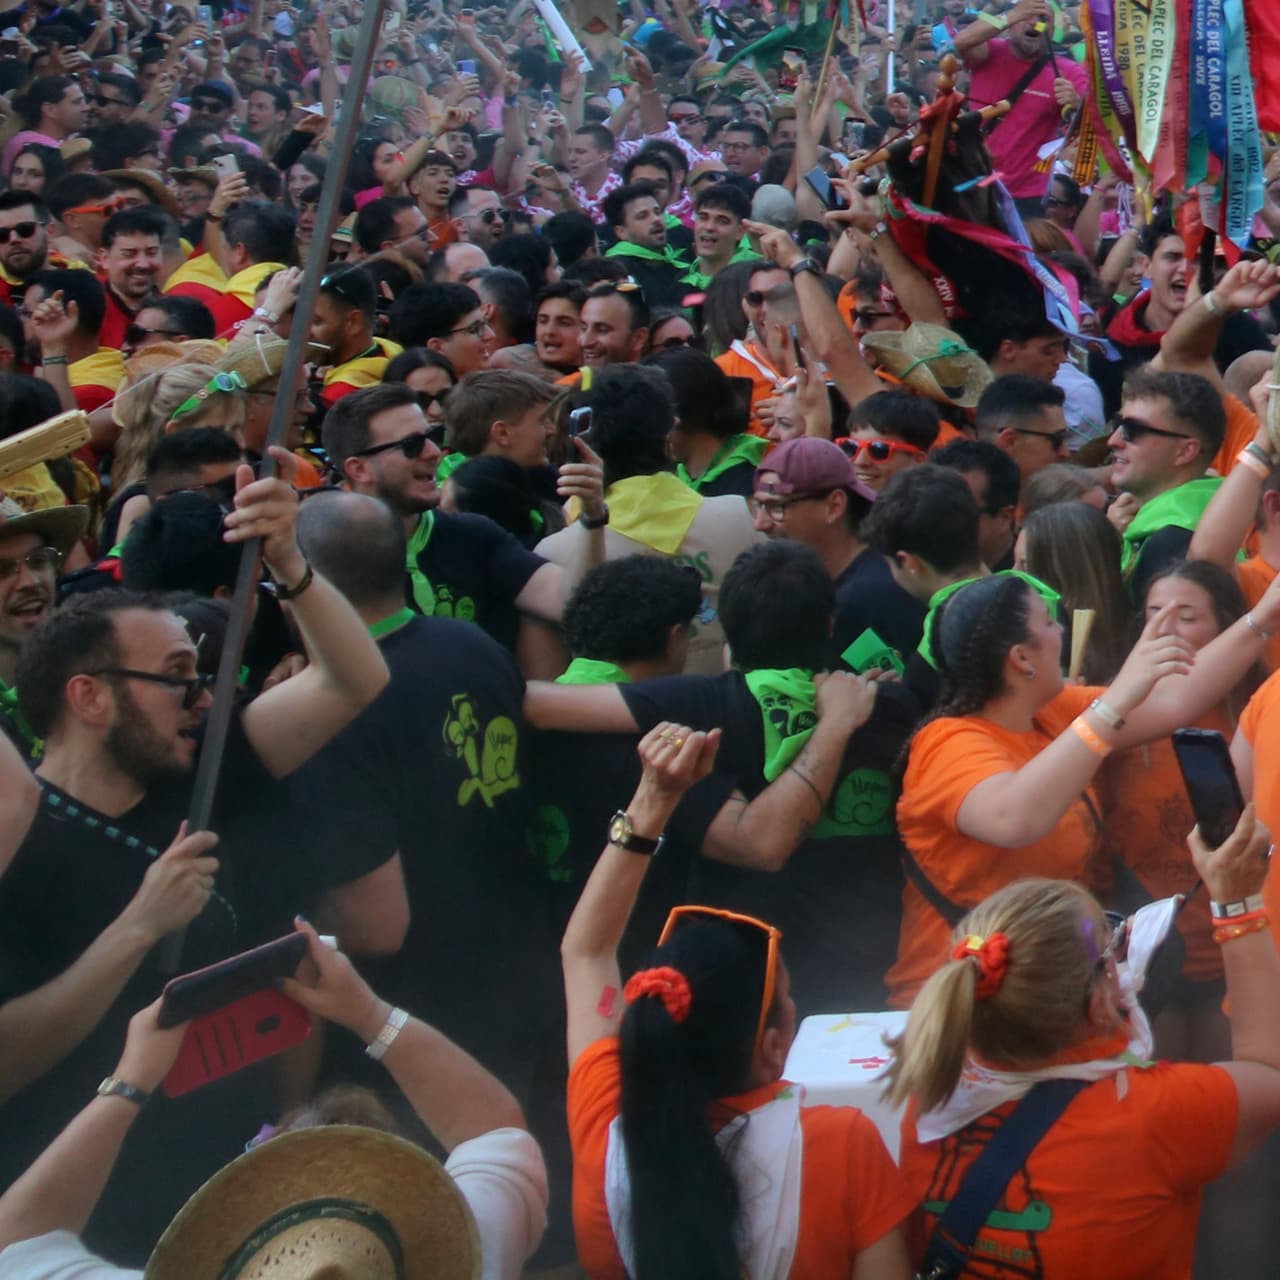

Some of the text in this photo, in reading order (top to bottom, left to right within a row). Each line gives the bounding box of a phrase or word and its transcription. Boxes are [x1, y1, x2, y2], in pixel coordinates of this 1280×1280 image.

[1096, 30, 1118, 81] LLEIDA
[1117, 41, 1130, 72] 1980
[1132, 34, 1147, 57] DEL
[1150, 39, 1165, 61] DEL
[1207, 31, 1222, 53] DEL
[1145, 64, 1163, 124] CARAGOL
[1207, 57, 1222, 120] CARAGOL
[1230, 73, 1244, 96] XIII
[1231, 100, 1245, 148] APLEC
[933, 273, 954, 304] XXIV
